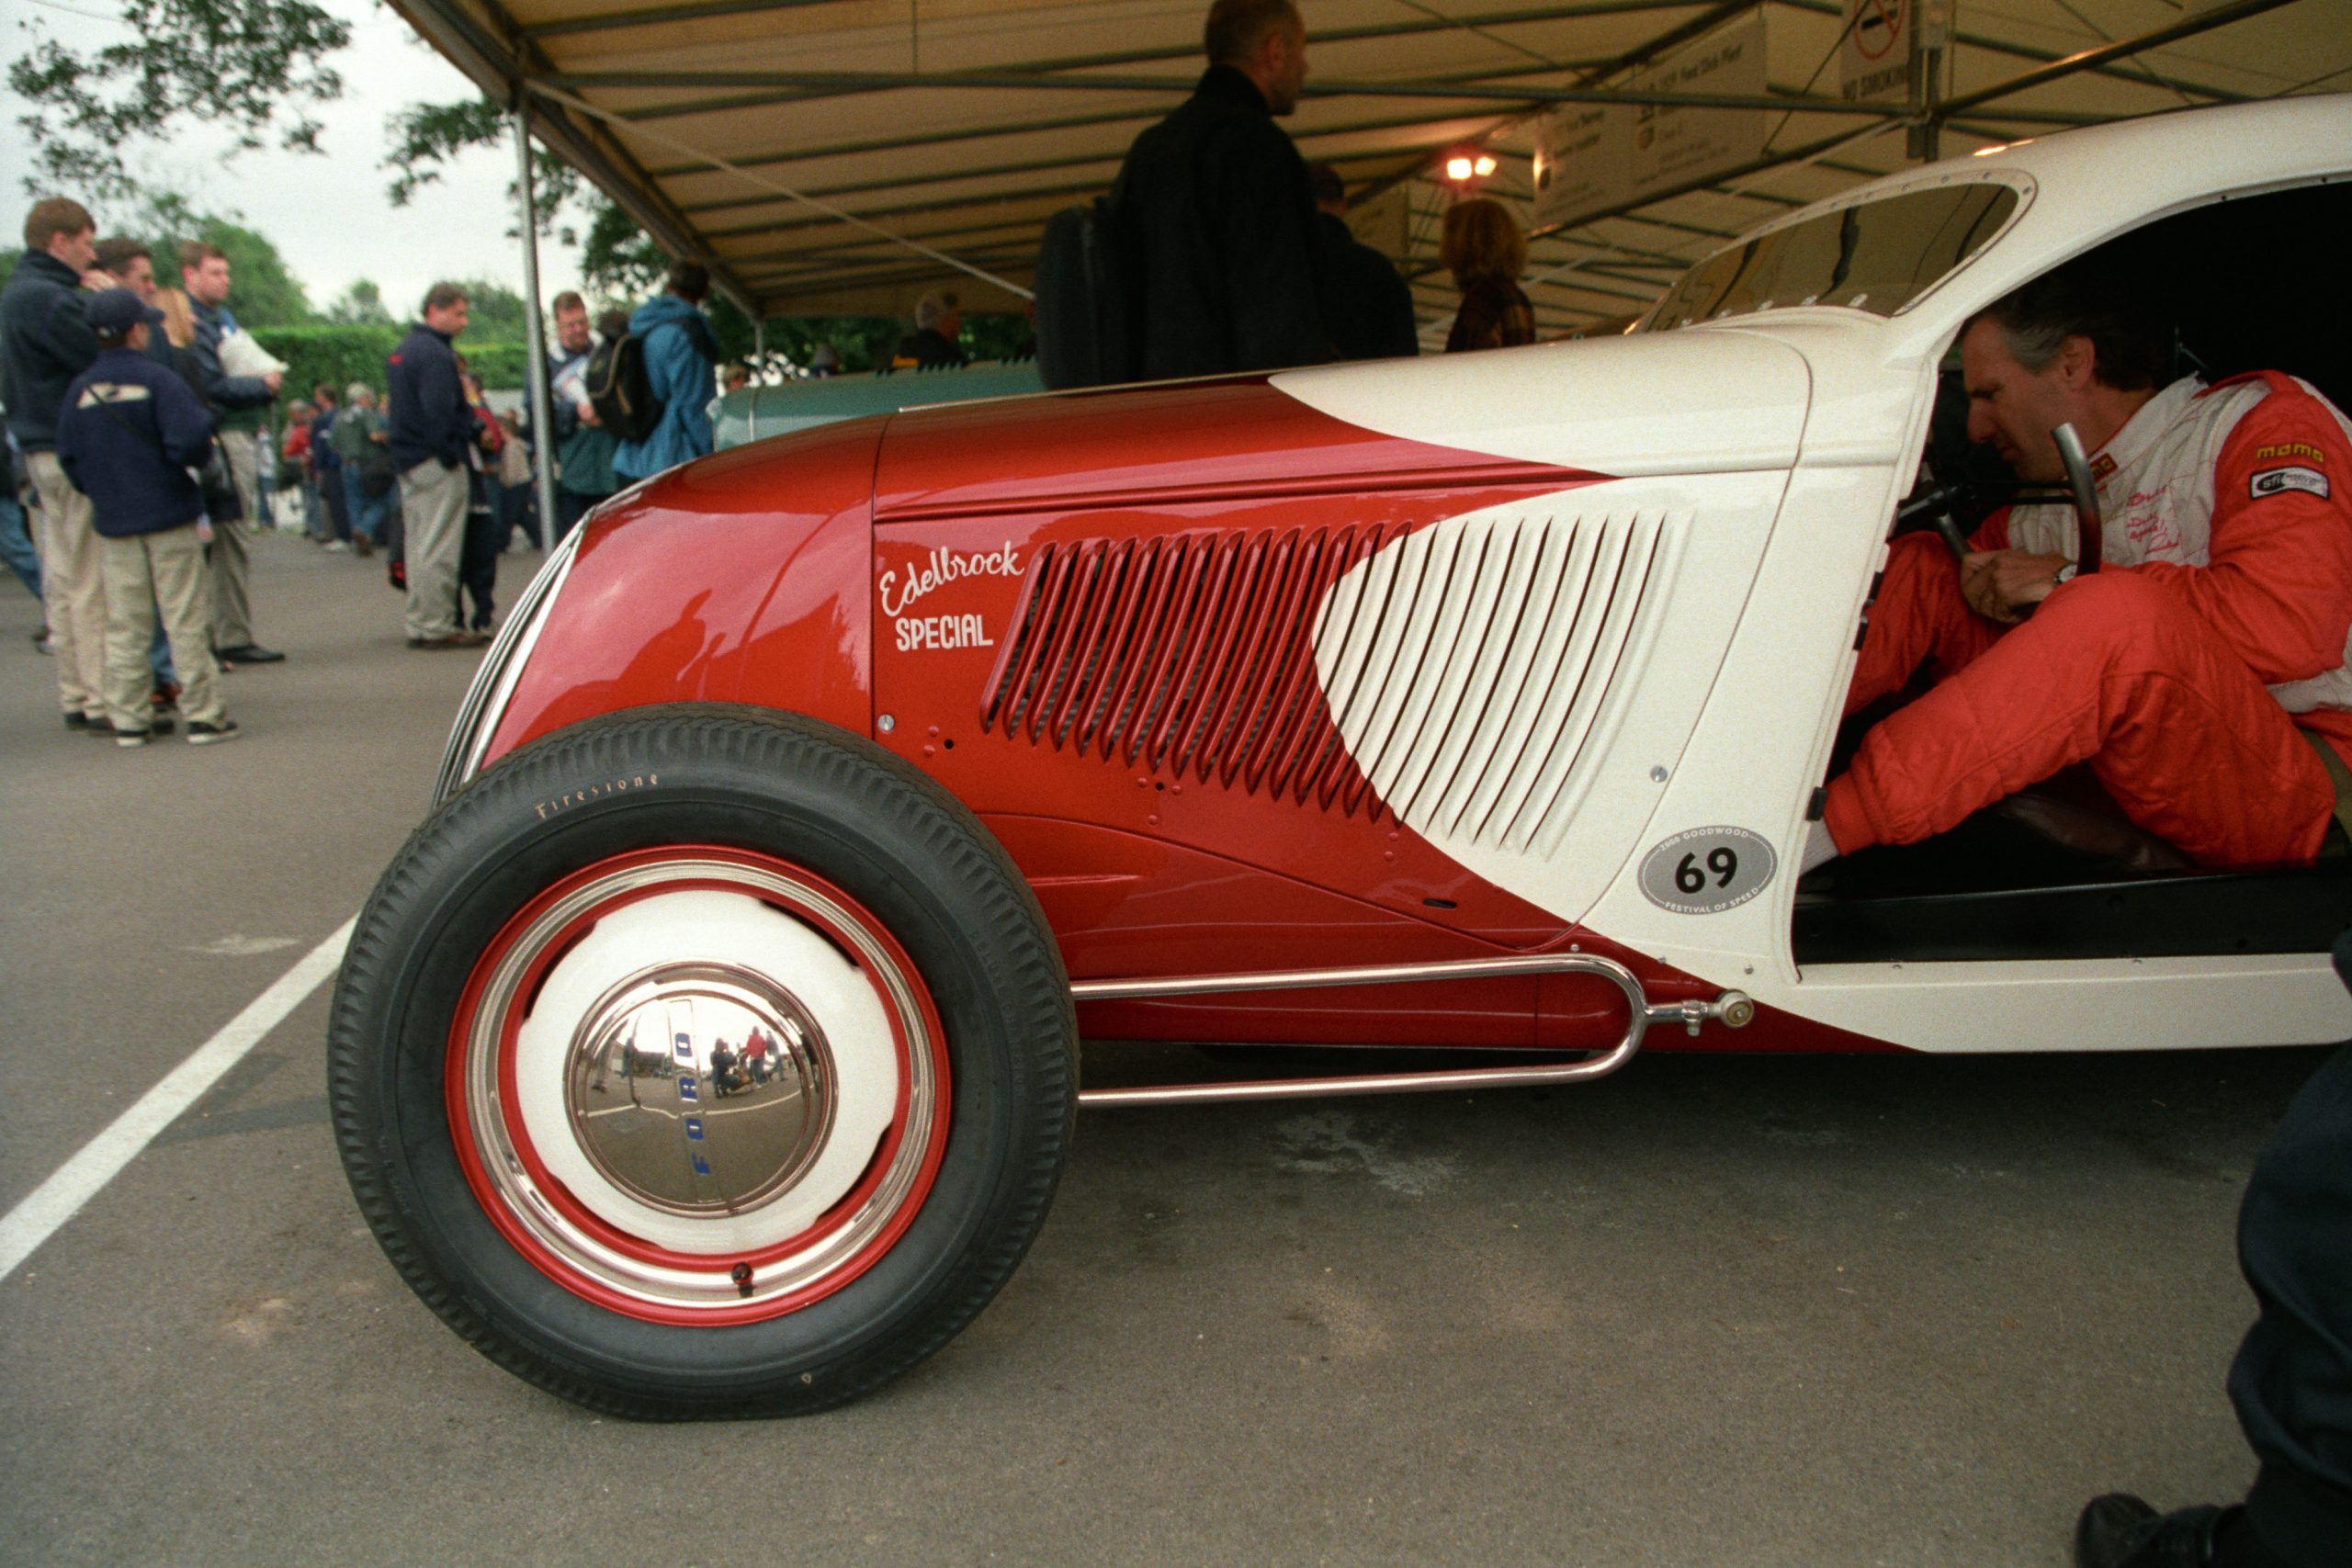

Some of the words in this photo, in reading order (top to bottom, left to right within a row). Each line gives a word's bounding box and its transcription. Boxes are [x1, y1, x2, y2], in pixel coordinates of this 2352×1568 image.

[1860, 64, 1908, 96] SMOKIN
[2256, 443, 2324, 463] momo
[879, 540, 1024, 617] Edelbrock
[896, 614, 993, 651] SPECIAL
[1660, 836, 1680, 851] 2000
[1682, 828, 1749, 840] GOODWOOD
[1675, 847, 1737, 895] 69
[1664, 901, 1713, 914] FESTIVAL
[1714, 903, 1727, 912] OF
[1730, 888, 1758, 907] SPEED
[675, 1032, 710, 1176] FORD
